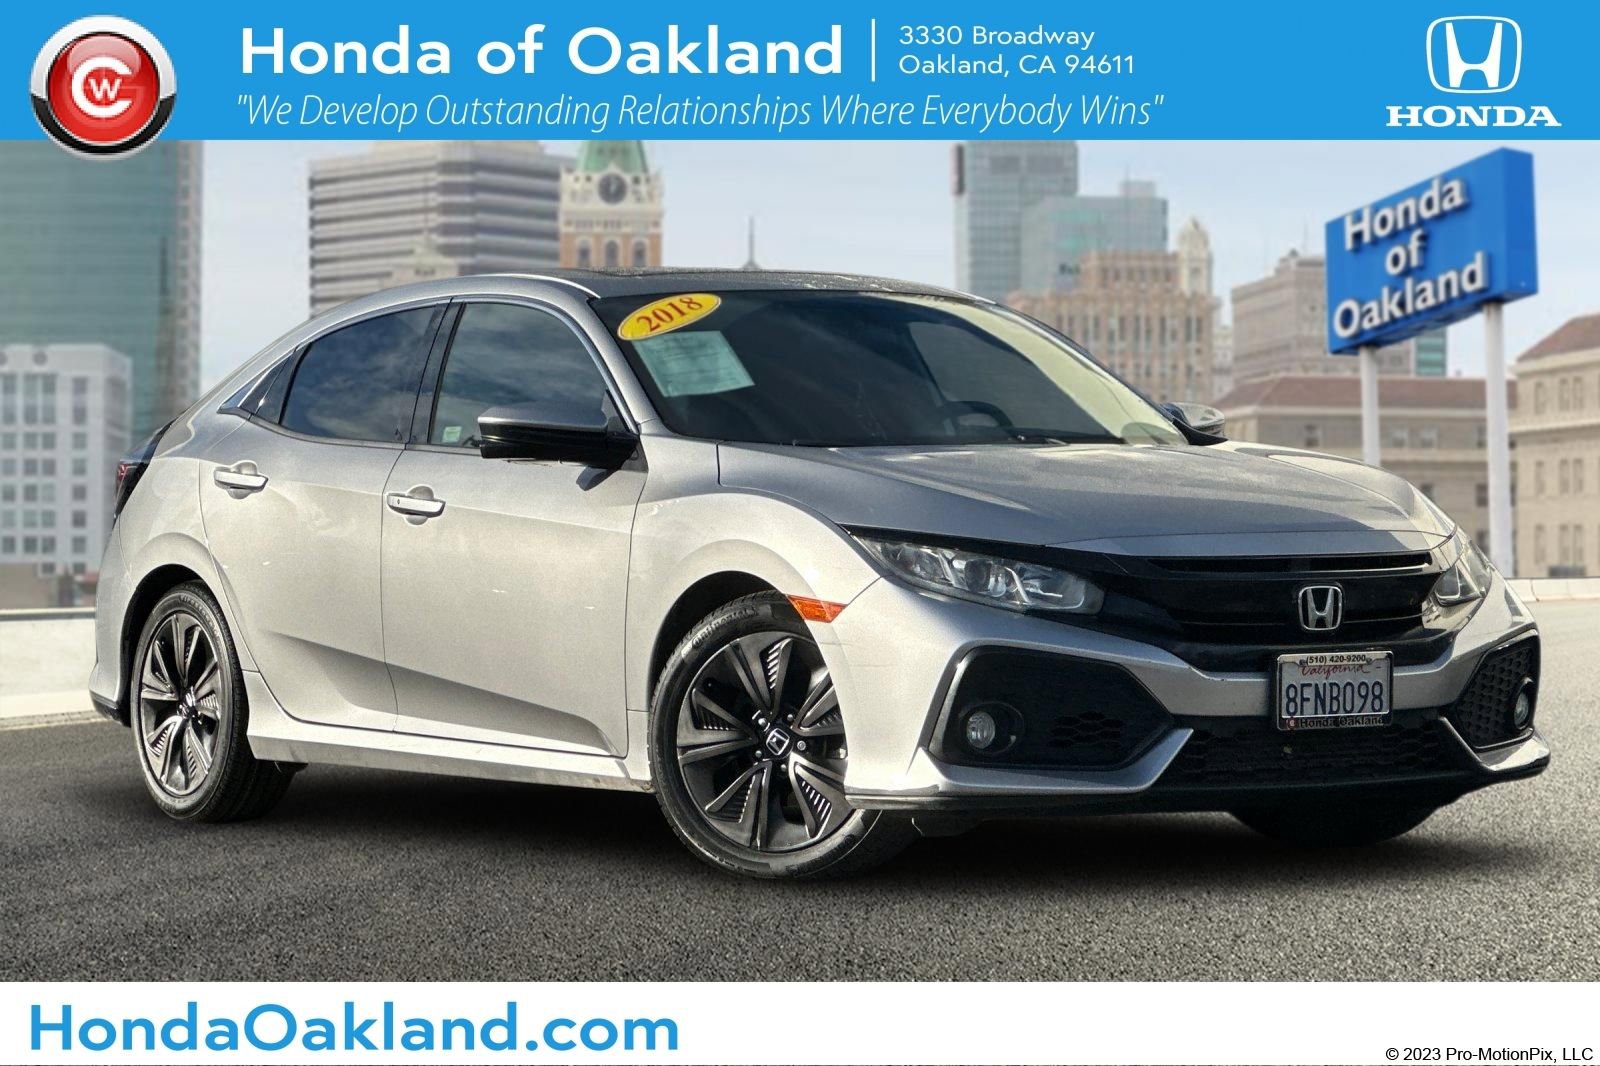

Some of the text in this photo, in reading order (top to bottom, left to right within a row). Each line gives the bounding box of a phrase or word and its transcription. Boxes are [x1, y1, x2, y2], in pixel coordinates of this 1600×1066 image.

[1344, 176, 1467, 251] Honda
[1385, 228, 1428, 276] of
[636, 296, 703, 332] 2018
[1332, 250, 1489, 338] Oakland
[1306, 654, 1367, 665] (510) 420-9200
[1285, 680, 1384, 716] 8FNB098
